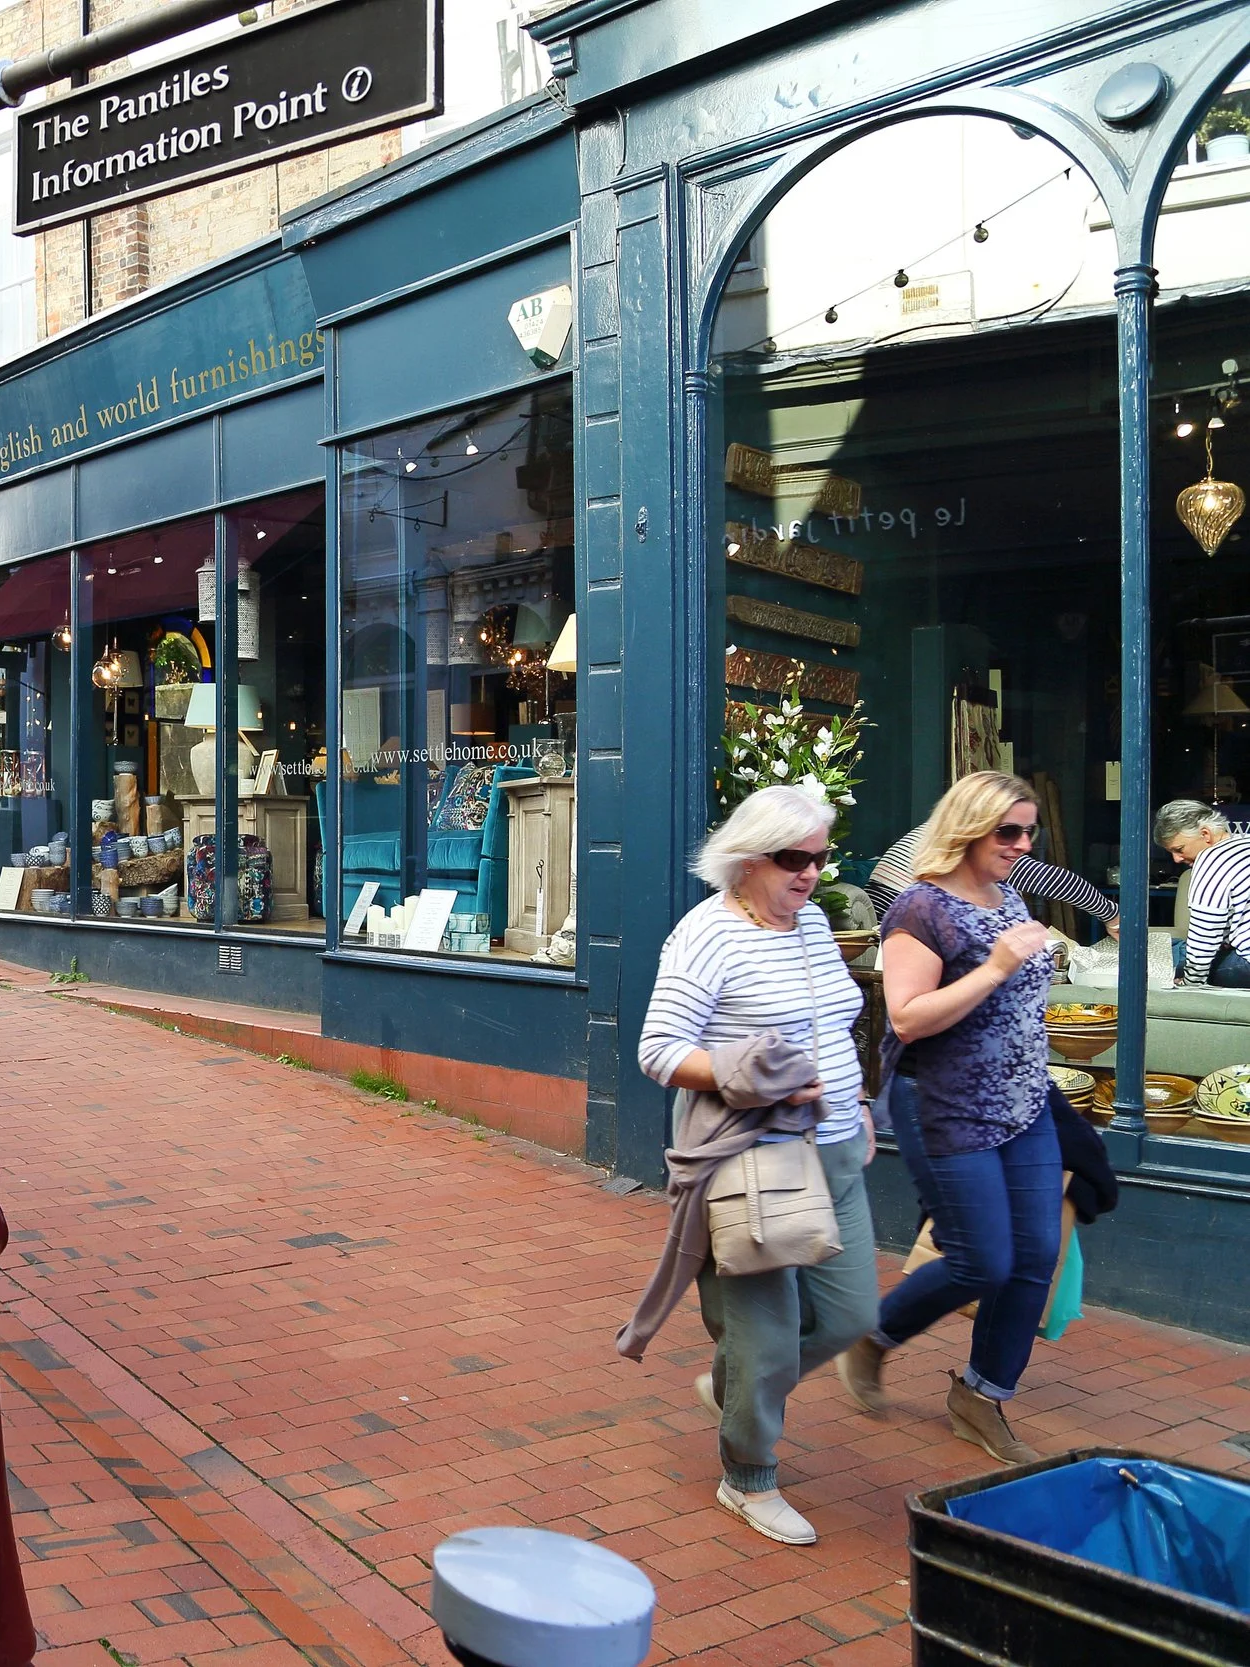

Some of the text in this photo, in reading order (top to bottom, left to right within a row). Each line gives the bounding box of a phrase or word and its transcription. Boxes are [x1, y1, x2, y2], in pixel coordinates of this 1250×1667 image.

[31, 81, 329, 202] Information Point
[32, 64, 230, 151] The Pantiles
[517, 298, 542, 322] AB
[52, 406, 89, 446] and
[97, 377, 160, 429] world
[171, 328, 327, 403] furnishings
[371, 738, 543, 764] www.settlehome.co.uk
